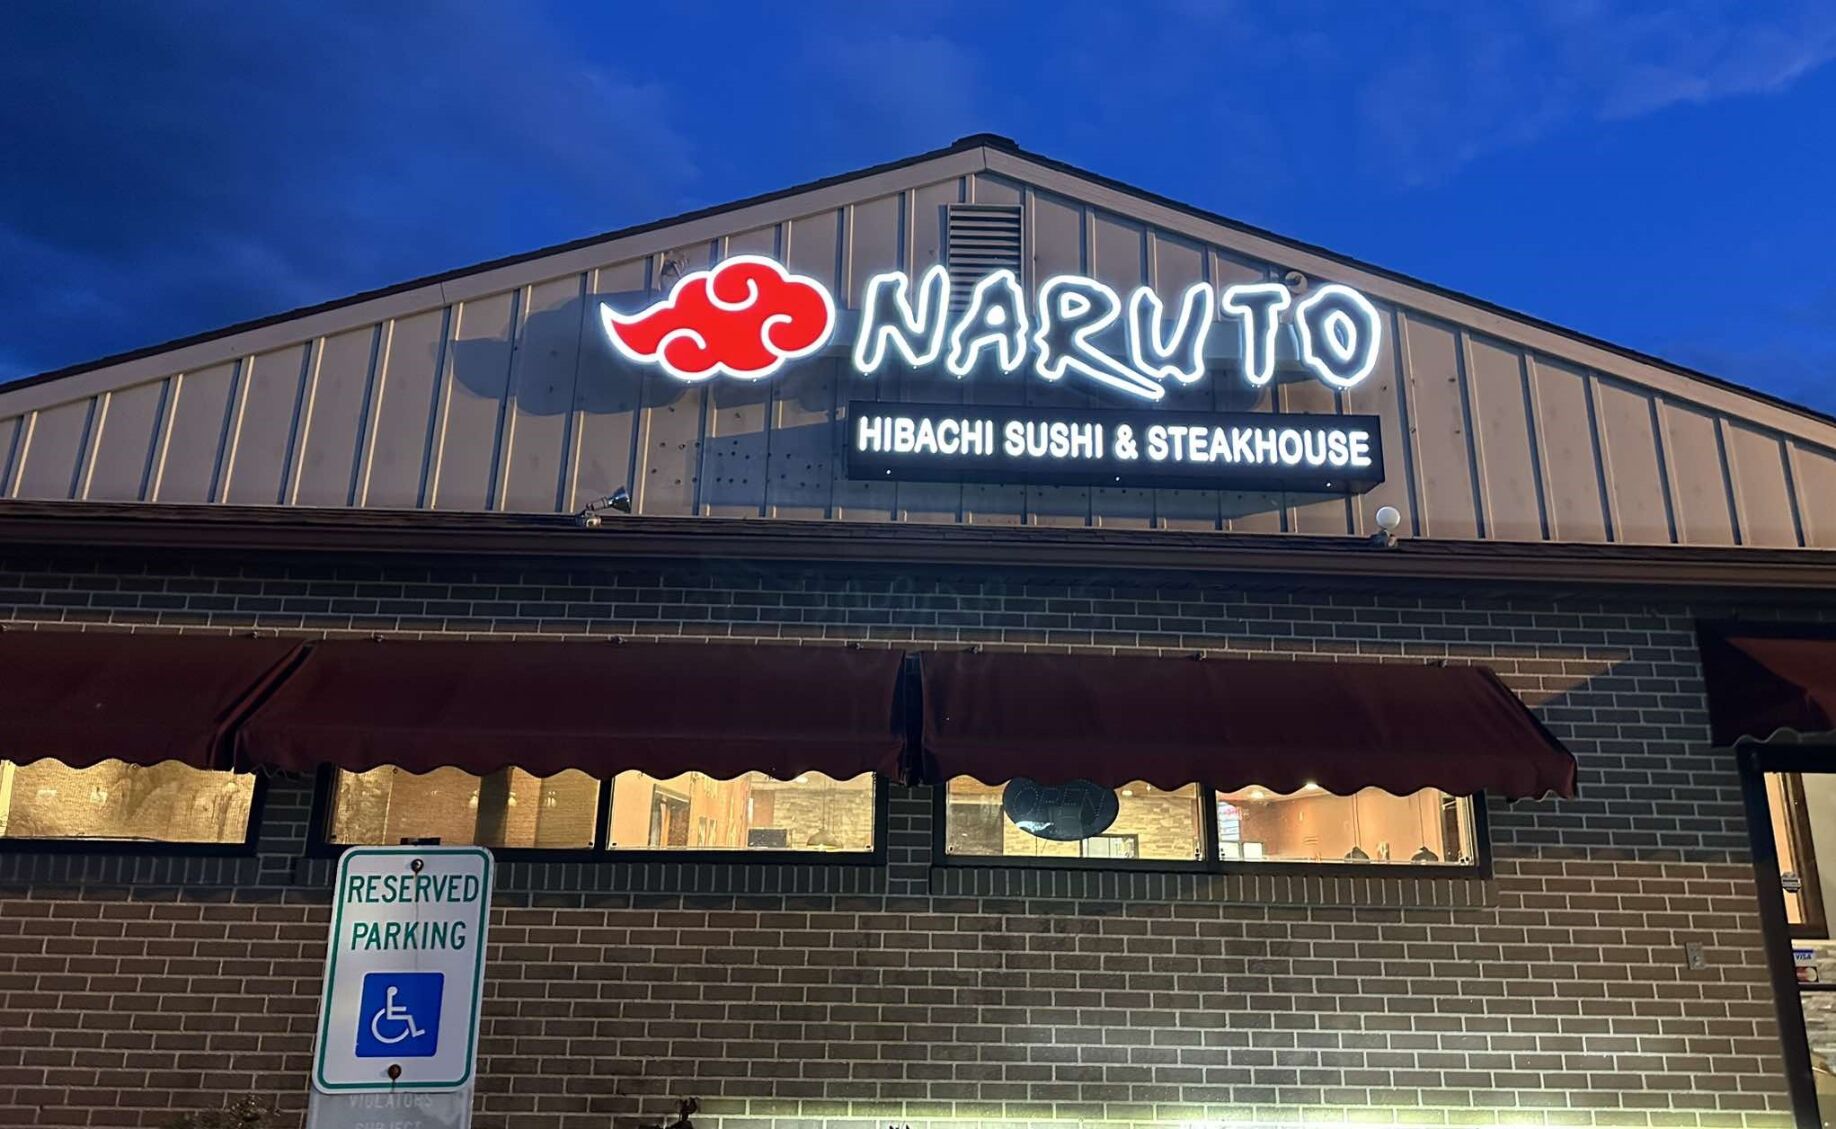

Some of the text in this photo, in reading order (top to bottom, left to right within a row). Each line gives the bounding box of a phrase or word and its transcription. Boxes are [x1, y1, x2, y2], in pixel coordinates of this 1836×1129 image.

[853, 264, 1383, 400] NARUTO
[857, 416, 1373, 467] HIBACHI SUSHI & STEAKHOUSE
[1013, 786, 1107, 825] OPEN
[348, 874, 480, 903] RESERVED
[351, 922, 466, 950] PARKING
